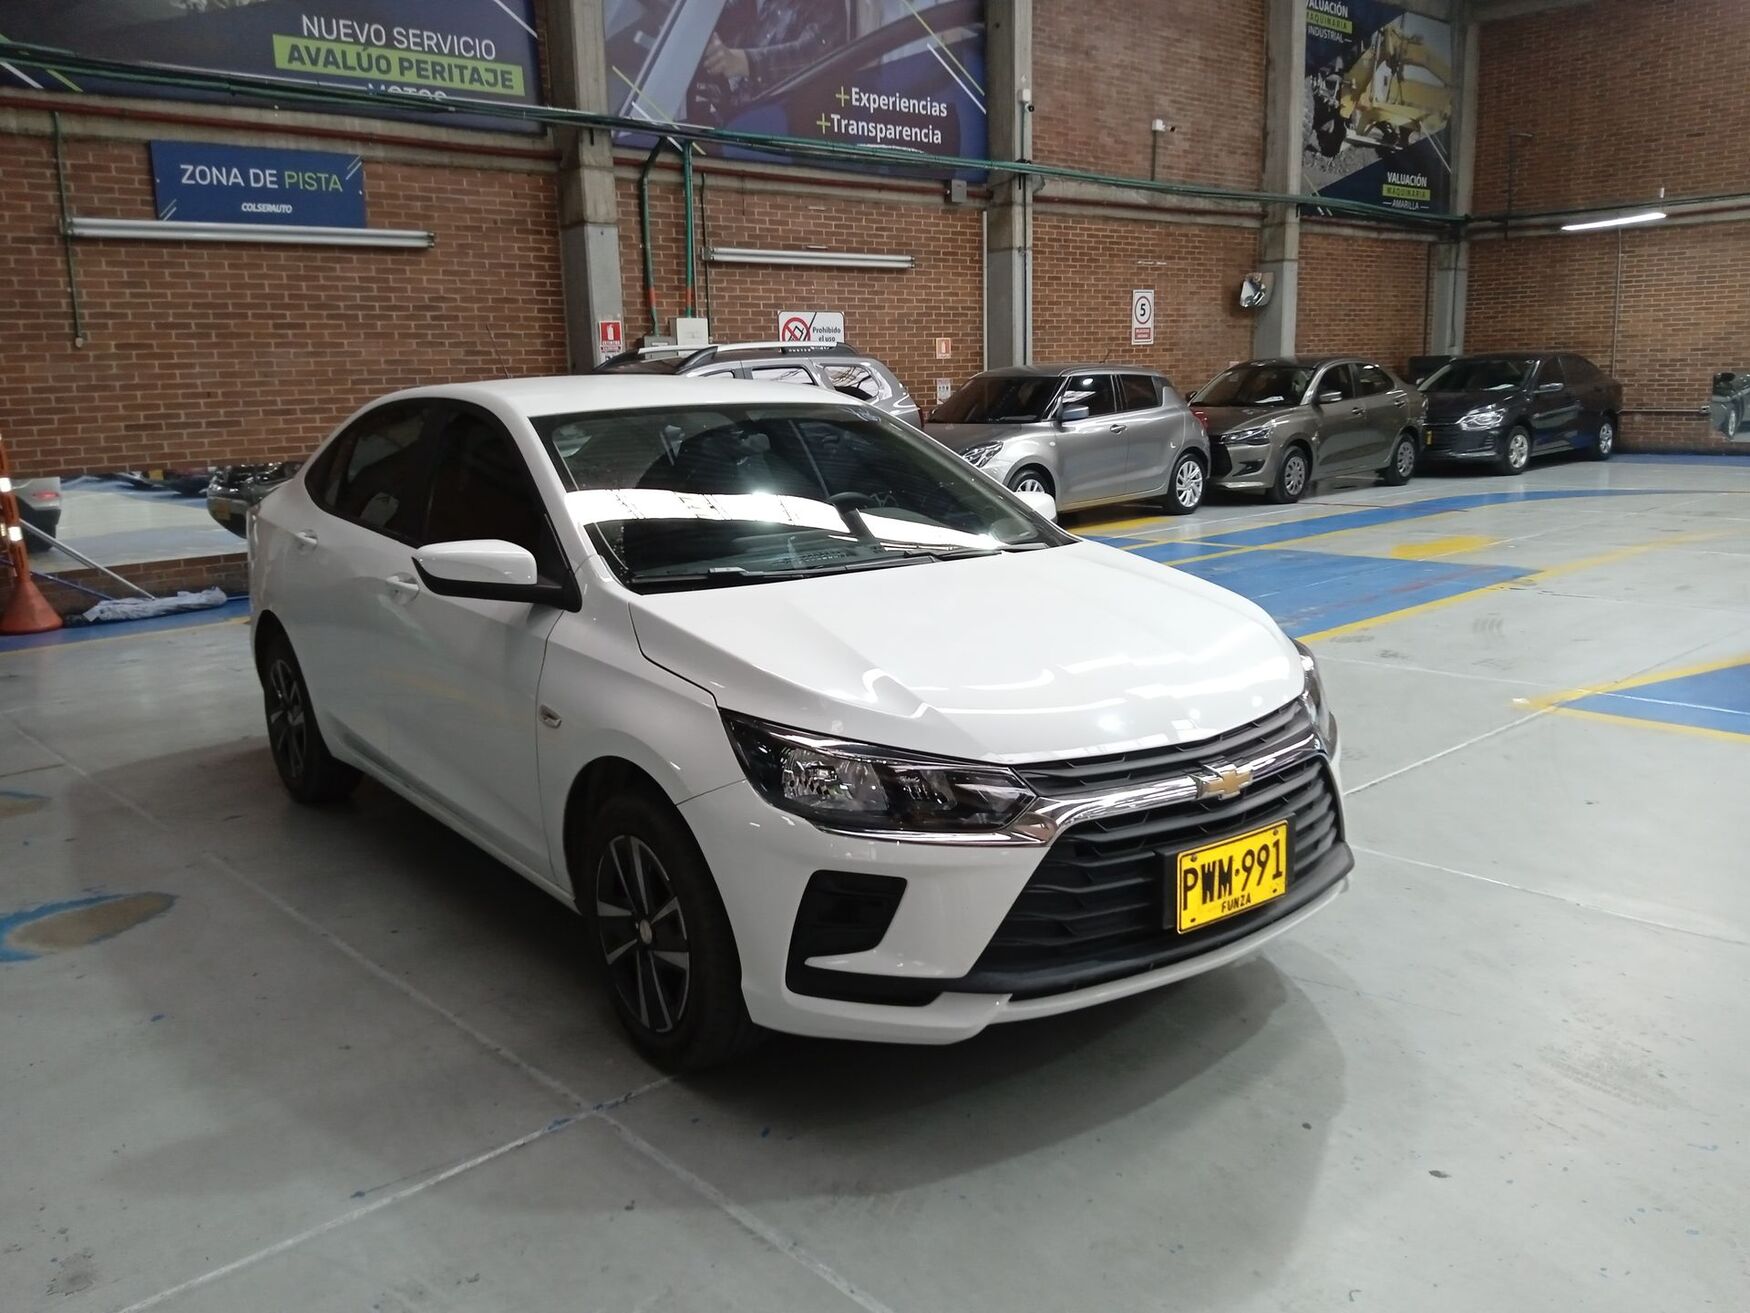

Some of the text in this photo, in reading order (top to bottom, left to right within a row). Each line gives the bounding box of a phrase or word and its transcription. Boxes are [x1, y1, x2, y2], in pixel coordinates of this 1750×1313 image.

[301, 13, 496, 60] NUEVO SERVICIO
[287, 43, 515, 90] AVALÚO PERITAJE
[180, 164, 344, 192] ZONA DE PISTA
[1387, 171, 1428, 187] VALUACIÓN
[241, 202, 293, 214] COLSERAUTO
[1140, 303, 1146, 317] 5
[812, 326, 841, 334] Prohibido
[1221, 892, 1252, 913] FUNZA
